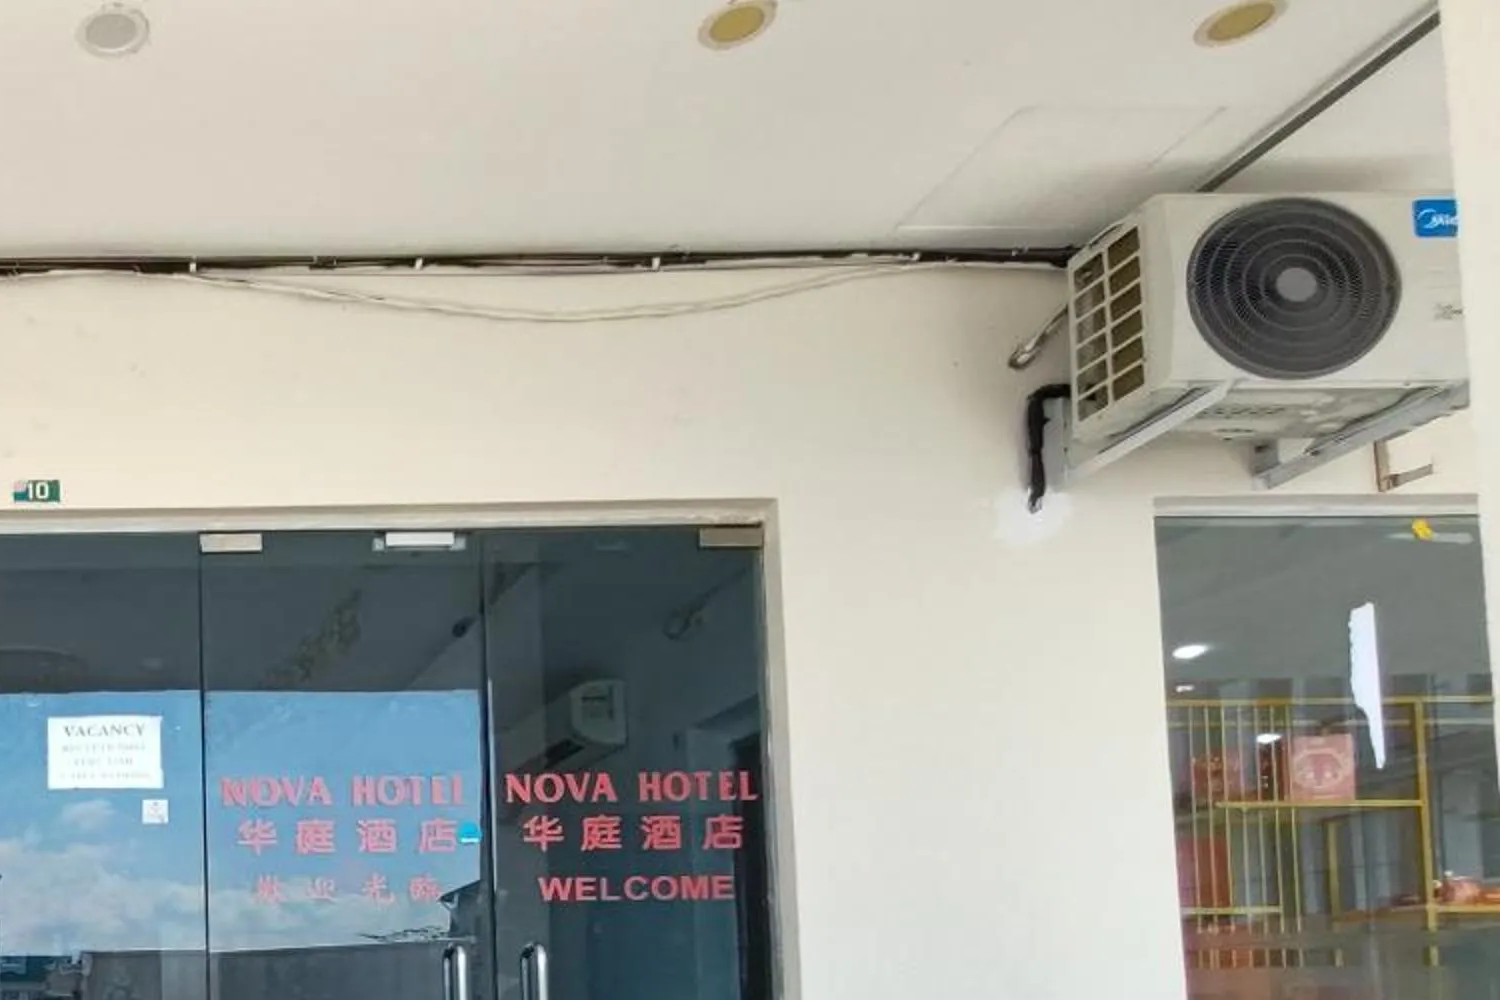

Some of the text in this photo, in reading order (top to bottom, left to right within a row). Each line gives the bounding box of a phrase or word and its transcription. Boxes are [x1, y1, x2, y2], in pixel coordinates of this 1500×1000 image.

[29, 482, 49, 499] 10
[64, 724, 144, 737] VACANCY
[220, 775, 465, 806] NOVA HOTEL
[505, 771, 758, 803] NOVA HOTEL
[237, 818, 457, 855] 华庭酒店
[523, 814, 745, 851] 华庭酒店
[537, 874, 735, 901] WELCOME
